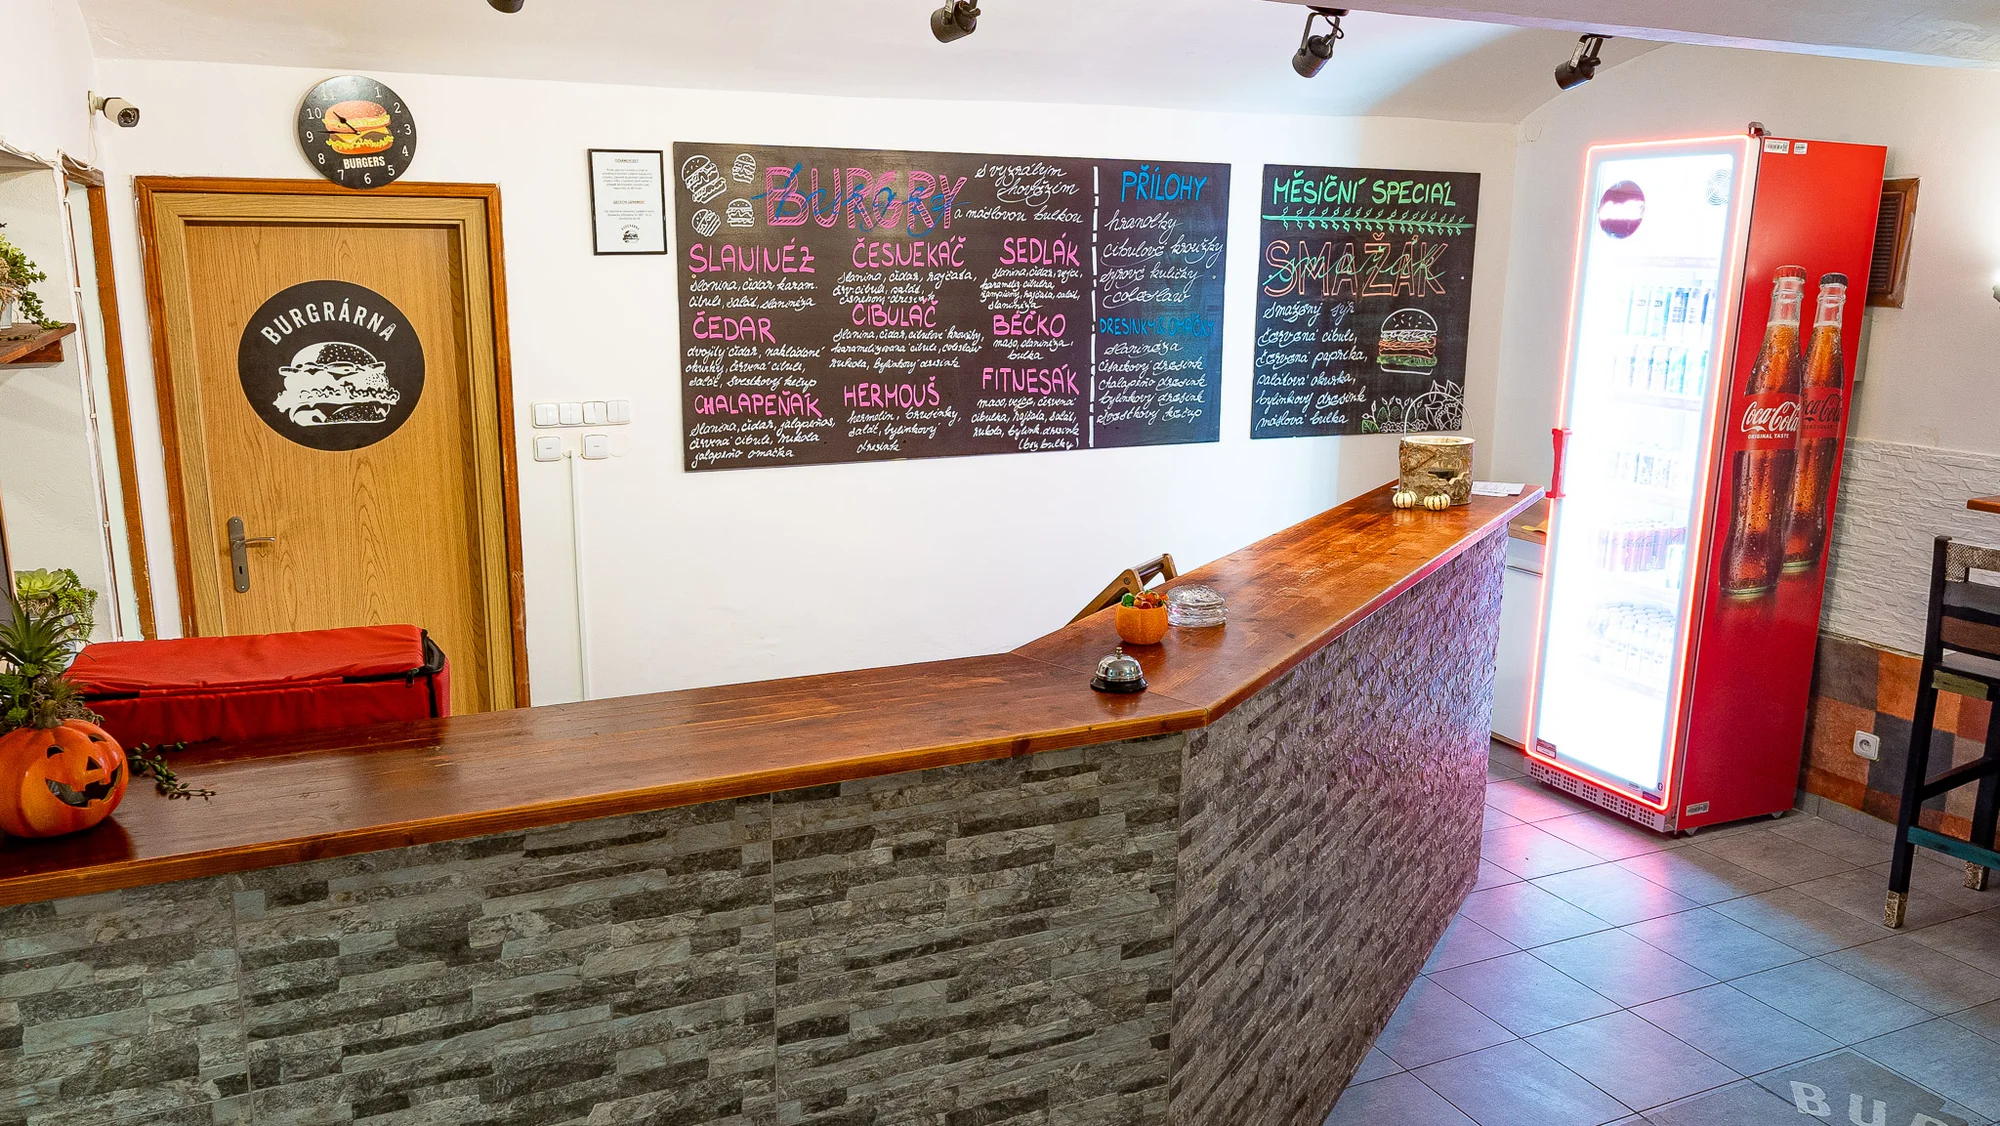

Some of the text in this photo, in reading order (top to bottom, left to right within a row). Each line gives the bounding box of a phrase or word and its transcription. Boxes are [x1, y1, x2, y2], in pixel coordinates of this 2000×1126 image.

[375, 87, 382, 98] 1
[306, 107, 322, 120] 10
[393, 102, 402, 114] 2
[306, 131, 314, 143] 9
[403, 124, 411, 137] 3
[318, 153, 326, 165] 8
[342, 155, 386, 170] BURGERS
[401, 145, 409, 157] 4
[337, 169, 345, 181] 7
[364, 173, 372, 185] 6
[388, 164, 396, 177] 5
[1120, 164, 1208, 203] PŘÍLOHY
[766, 166, 968, 230] BURGRY
[1273, 169, 1367, 206] MĚSÍČNÍ
[954, 208, 964, 220] a
[852, 235, 967, 269] ČESNEKÁČ
[1000, 232, 1080, 267] SEDLÁK
[1263, 231, 1450, 298] SMAŽÁK
[260, 297, 397, 345] BURGRÁRNA
[852, 297, 940, 328] CIBULÁČ
[993, 310, 1066, 338] BÉČKO
[692, 310, 776, 344] ČEDAR
[844, 375, 941, 409] HERMOUŠ
[982, 363, 1080, 396] FITNESÁK
[694, 390, 823, 419] CHALAPEŇÁK
[1741, 401, 1800, 432] Coca-Cola
